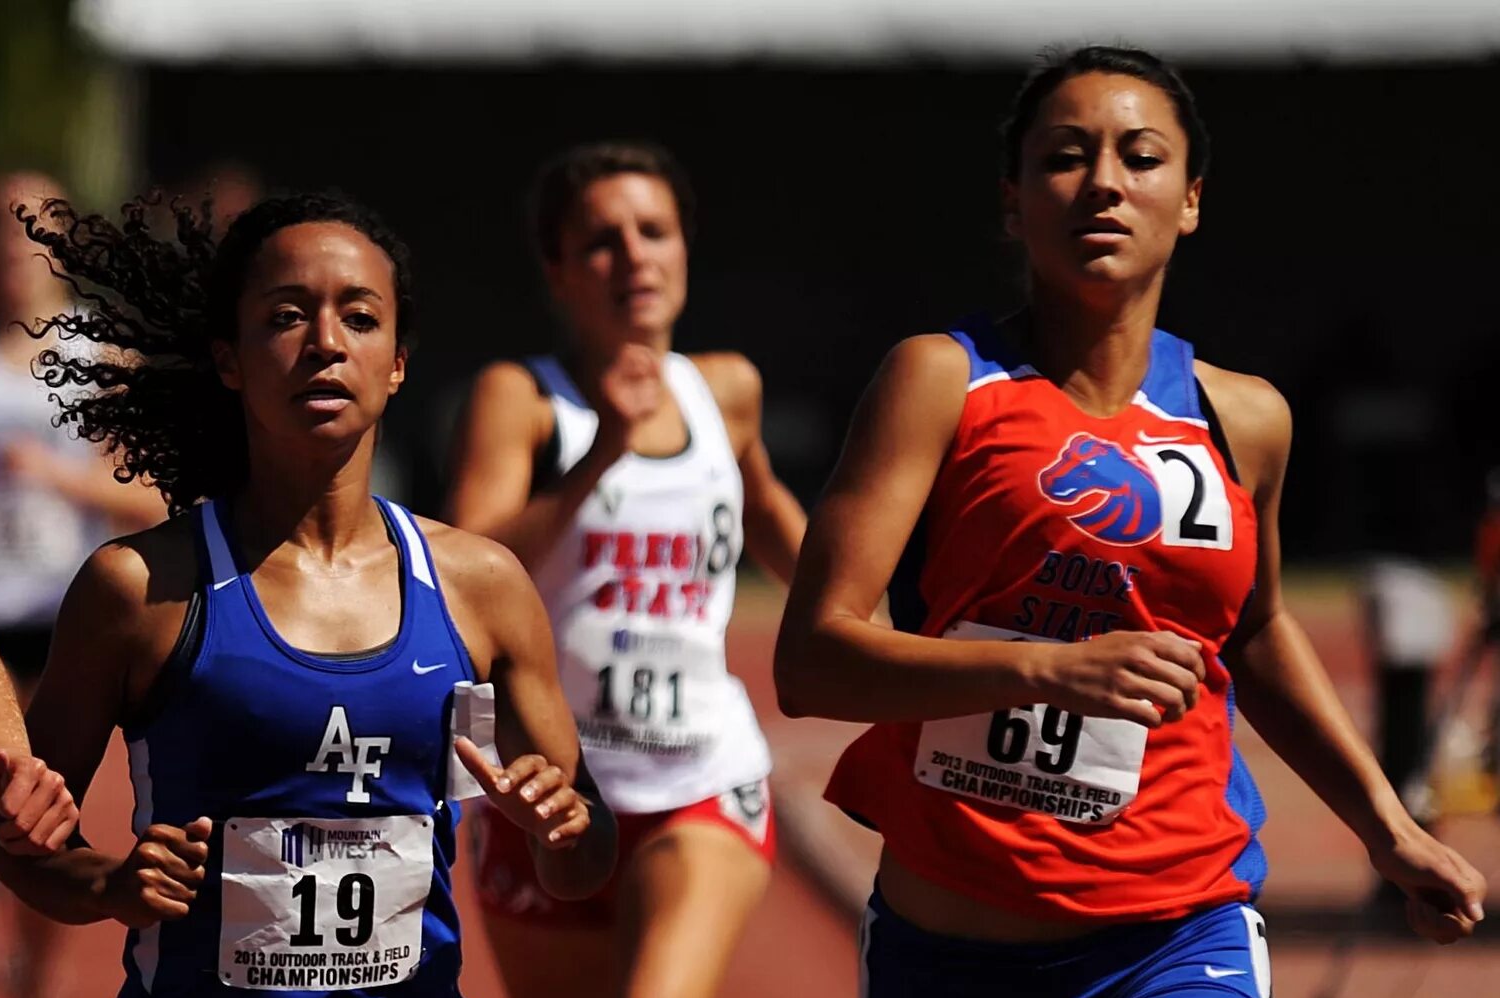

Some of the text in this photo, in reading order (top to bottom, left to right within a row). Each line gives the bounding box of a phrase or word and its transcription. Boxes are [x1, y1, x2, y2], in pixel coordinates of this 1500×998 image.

[1156, 449, 1218, 542] 2
[707, 503, 732, 574] 8
[1034, 549, 1141, 605] BOISE
[598, 664, 684, 722] 181
[987, 704, 1083, 775] 69
[931, 751, 1121, 806] 2013 OUTDOOR TRACK & FIELD
[940, 771, 1104, 822] CHAMPIONSHIPS
[328, 829, 381, 841] MOUNTAIN
[328, 842, 380, 860] WEST
[289, 872, 375, 947] 19
[234, 946, 410, 967] 2013 OUTDOOR TRACK & FIELD
[246, 963, 399, 986] CHAMPIONSHIPS
